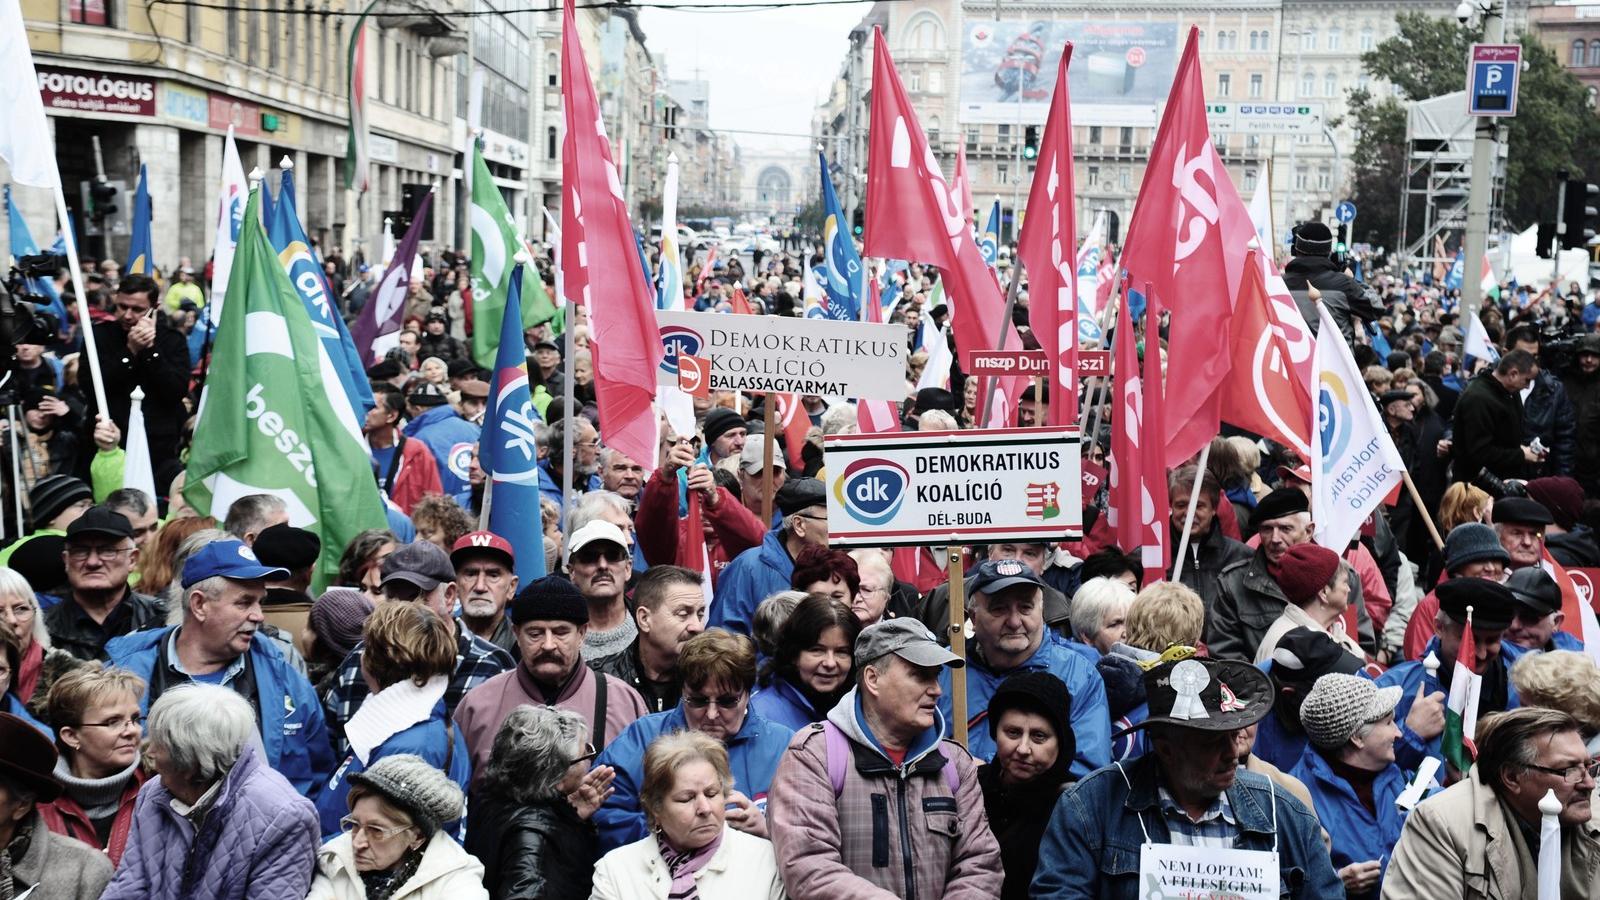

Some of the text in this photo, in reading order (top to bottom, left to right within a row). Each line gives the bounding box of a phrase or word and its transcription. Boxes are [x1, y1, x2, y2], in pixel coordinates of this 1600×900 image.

[38, 72, 154, 101] FOTOLÓGUS
[665, 339, 688, 356] dk
[711, 329, 898, 358] DEMOKRATIKUS
[711, 353, 825, 377] KOALÍCIÓ
[975, 356, 1016, 371] mszp
[710, 374, 848, 396] BALASSAGYARMAT
[916, 451, 1060, 474] DEMOKRATIKUS
[856, 476, 889, 502] dk
[917, 479, 1003, 503] KOALÍCIÓ
[928, 511, 992, 526] DÉL-BUDA
[470, 534, 493, 547] W
[1159, 859, 1263, 879] NEM LOPTAM!
[1160, 875, 1262, 895] A FELESÉGEM
